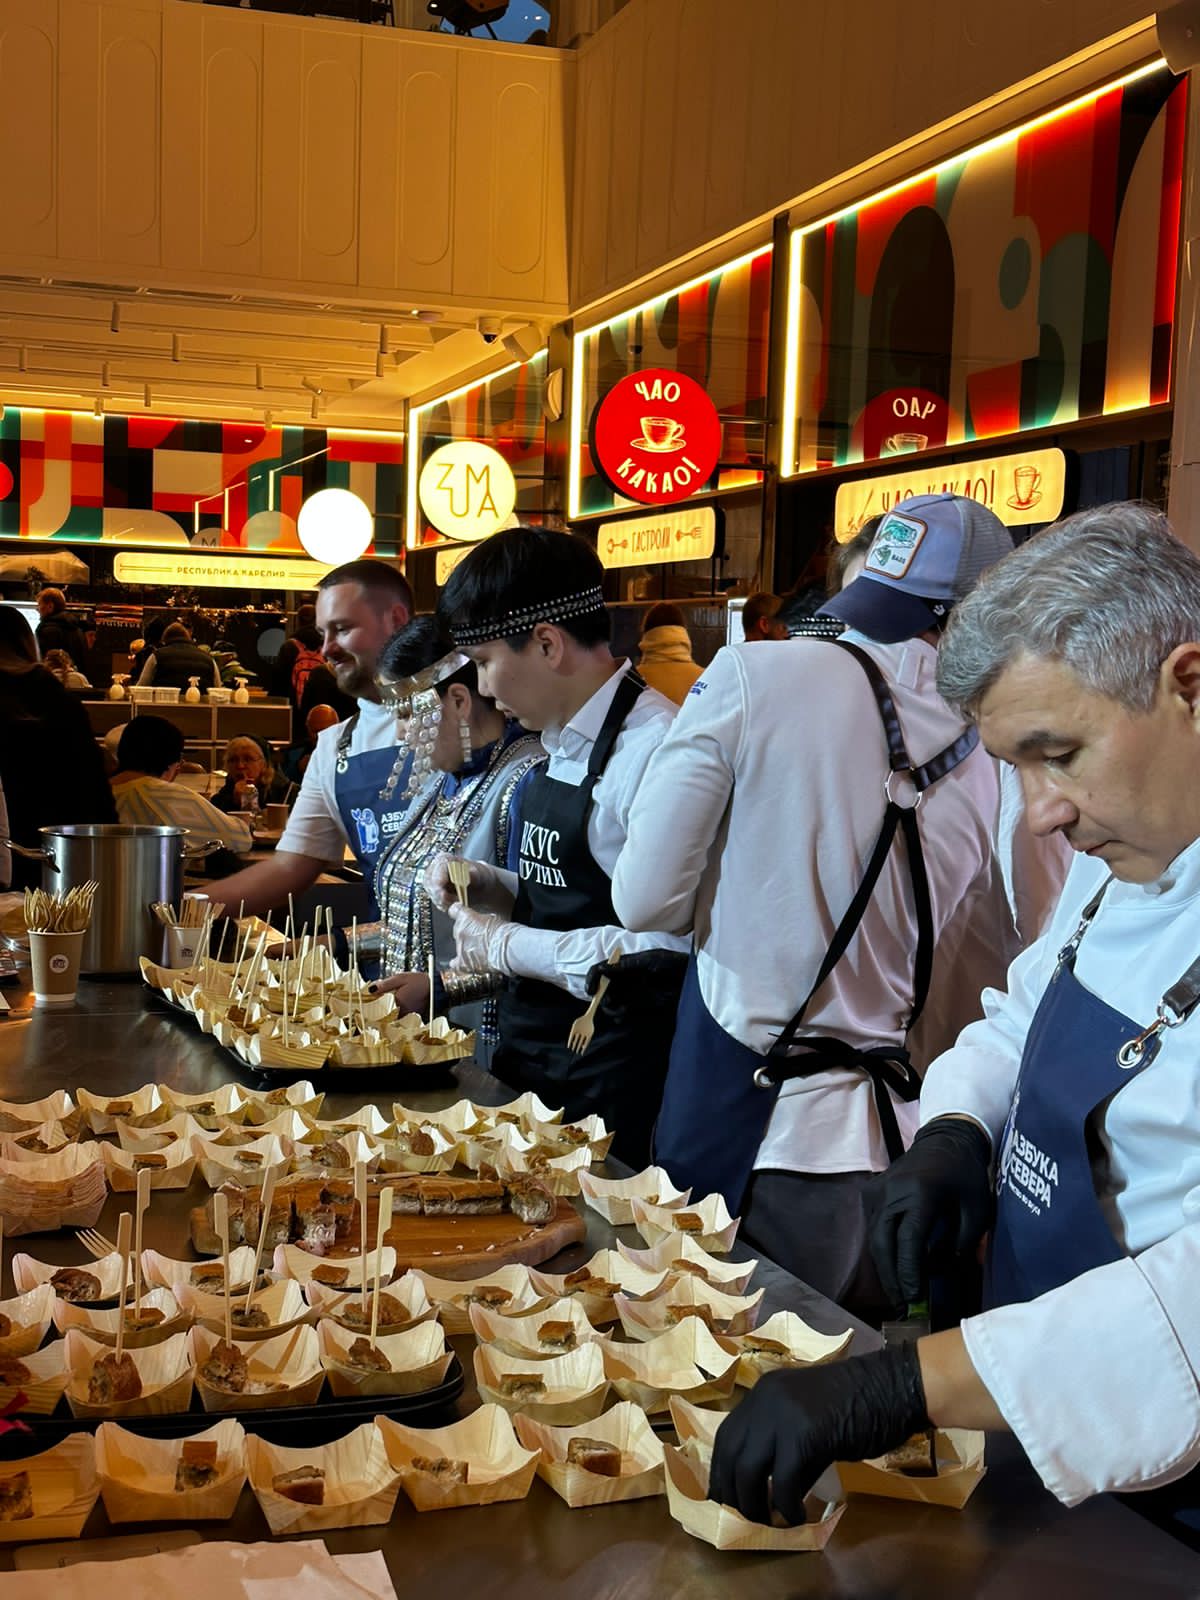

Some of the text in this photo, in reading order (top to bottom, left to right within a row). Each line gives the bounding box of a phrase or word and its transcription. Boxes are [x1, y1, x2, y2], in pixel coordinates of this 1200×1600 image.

[635, 378, 681, 403] ЧАО
[615, 456, 701, 494] КАКАО!
[631, 526, 671, 553] ГАСТРОЛИ
[177, 566, 286, 578] РЕСПУБЛИКА КАРЕЛИЯ
[1012, 1129, 1059, 1186] АЗБУКА
